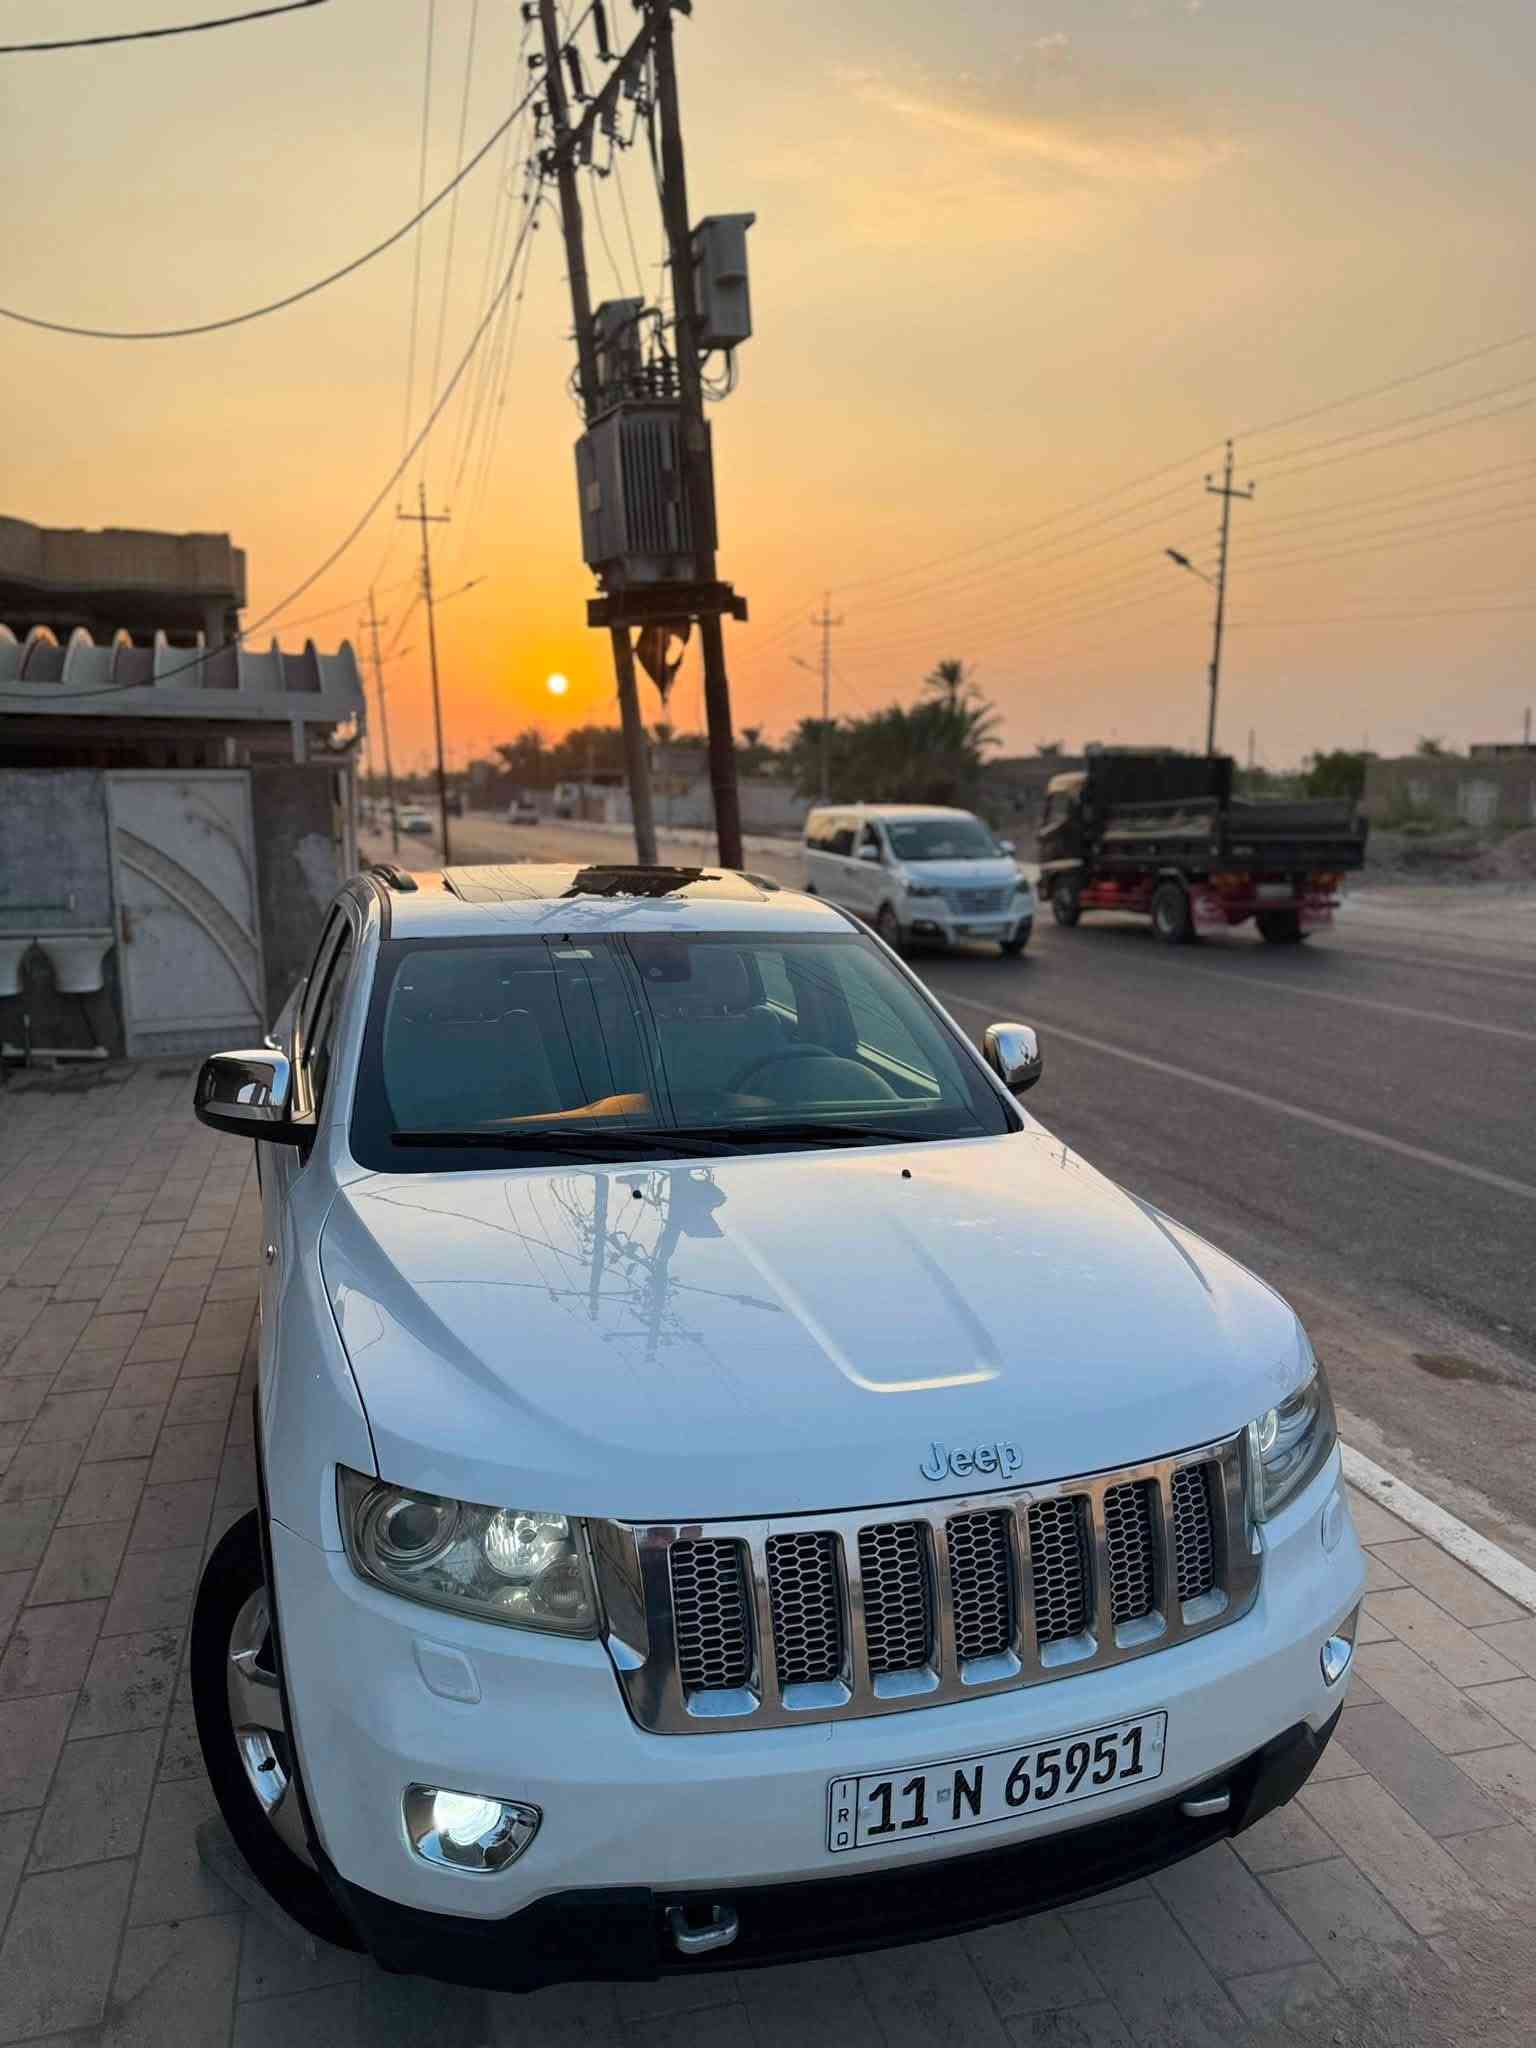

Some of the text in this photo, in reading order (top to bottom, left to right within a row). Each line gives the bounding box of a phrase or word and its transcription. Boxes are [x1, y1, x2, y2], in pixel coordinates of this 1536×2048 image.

[920, 1440, 1023, 1481] Jeep
[867, 1726, 1143, 1835] 11 N 65951
